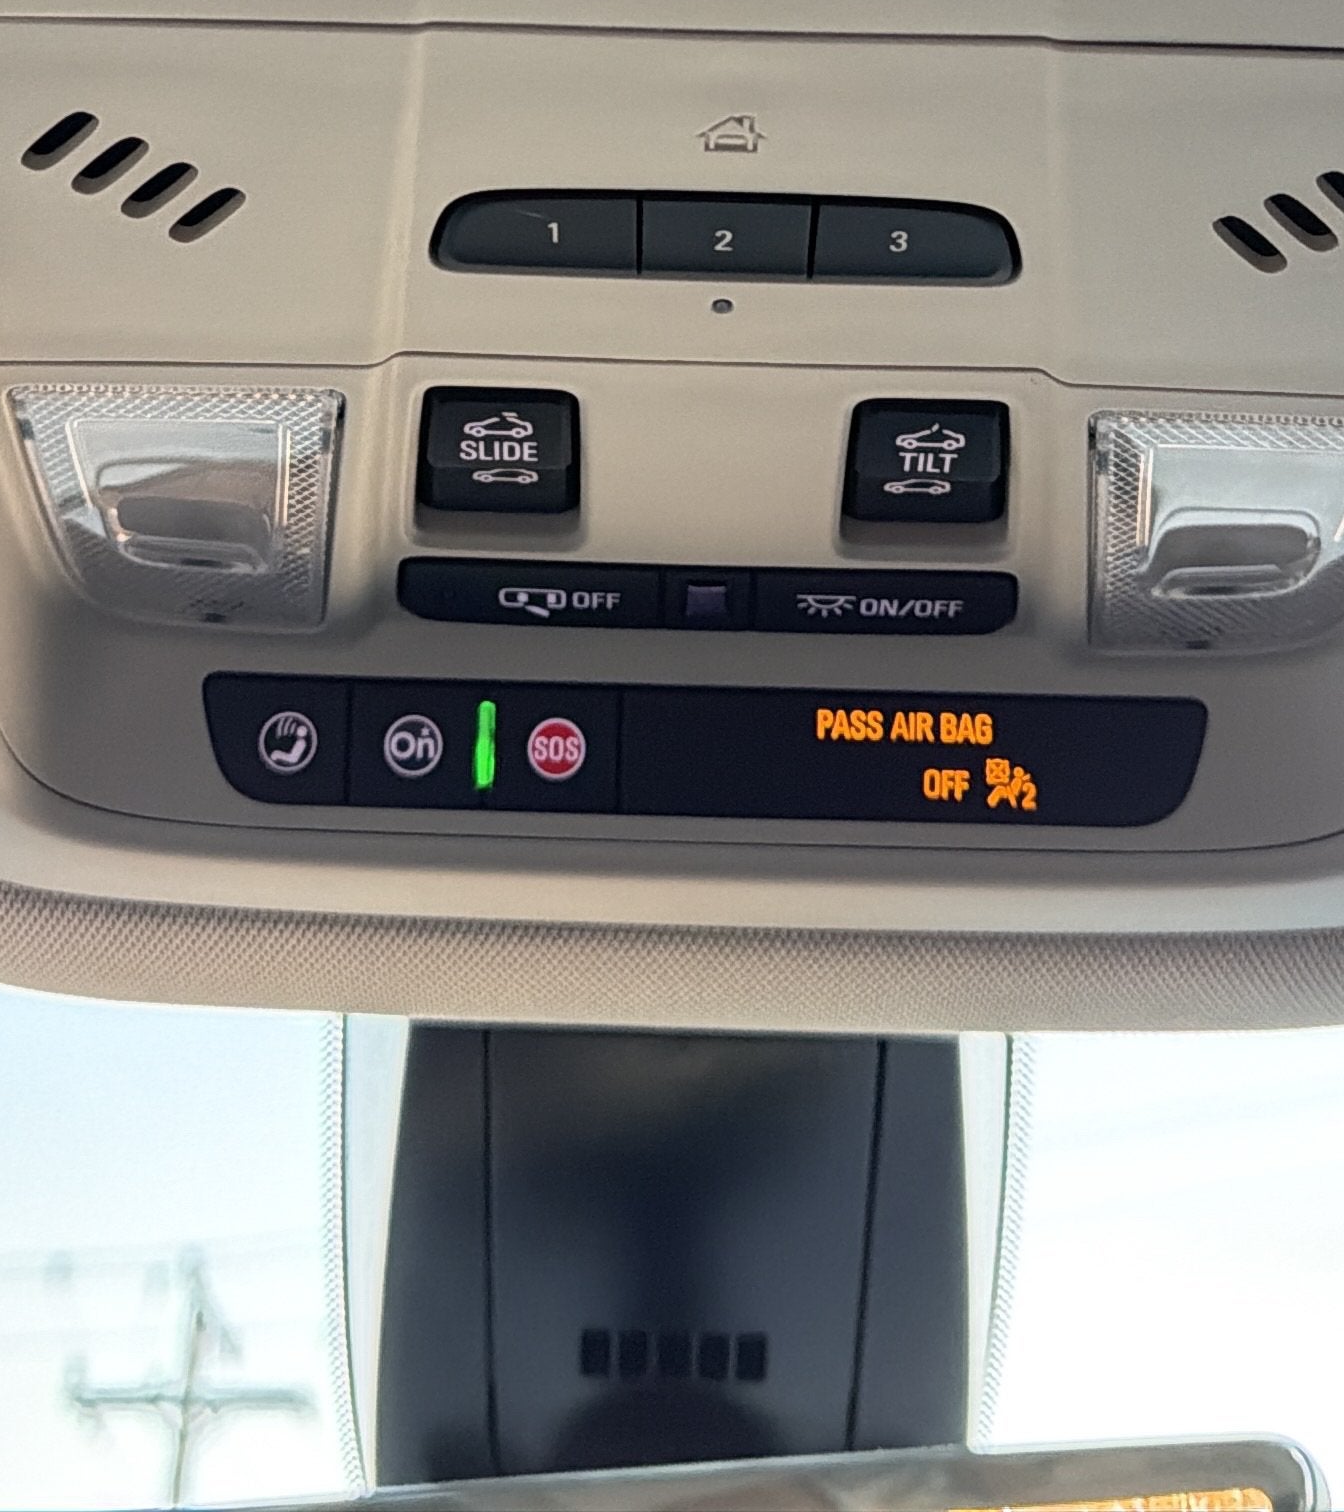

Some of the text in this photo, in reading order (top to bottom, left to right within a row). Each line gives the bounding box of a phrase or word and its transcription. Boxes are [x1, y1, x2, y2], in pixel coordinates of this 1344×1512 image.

[546, 222, 560, 245] 1
[713, 229, 734, 252] 2
[888, 231, 909, 254] 3
[459, 440, 539, 463] SLIDE
[898, 451, 958, 474] TILT
[571, 591, 622, 612] OFF
[859, 597, 964, 620] ON/OFF
[816, 708, 994, 745] PASS AIR BAG
[533, 735, 580, 763] SOS
[922, 767, 971, 802] OFF
